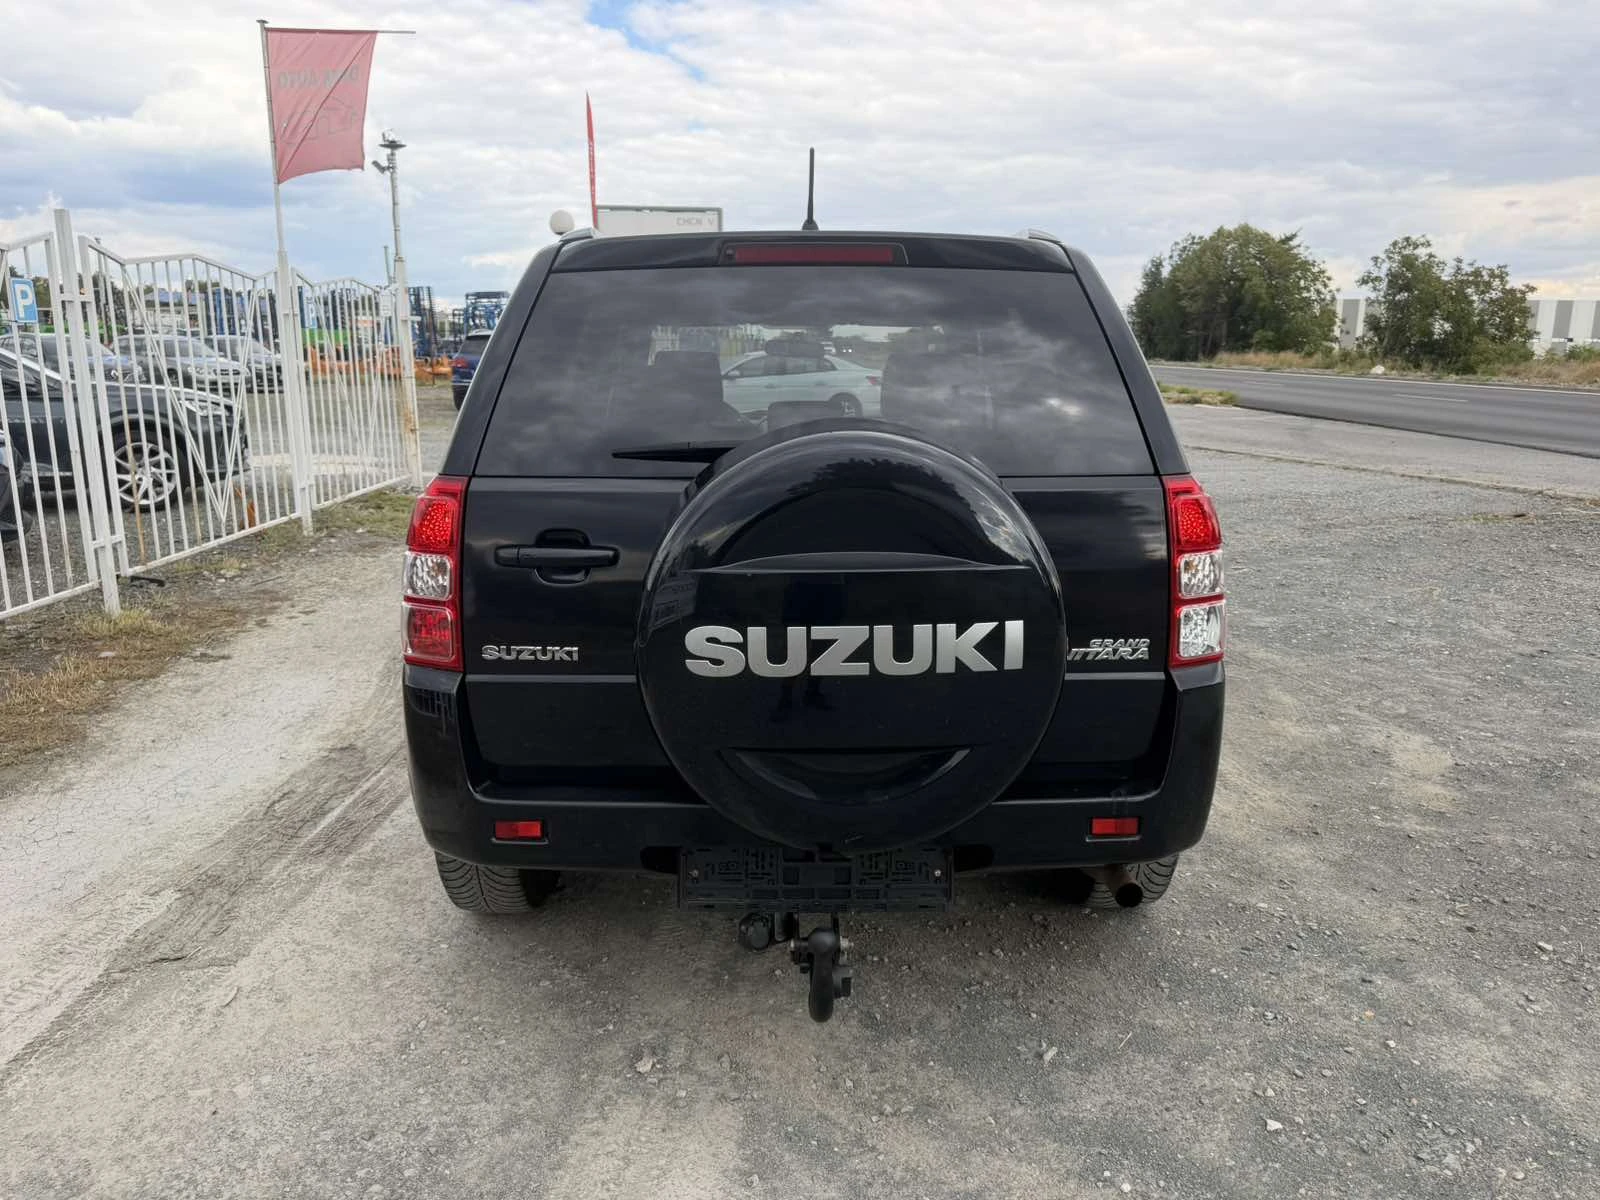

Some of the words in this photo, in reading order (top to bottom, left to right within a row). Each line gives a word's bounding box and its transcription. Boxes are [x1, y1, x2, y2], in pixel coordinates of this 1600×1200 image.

[15, 283, 33, 318] P
[481, 645, 579, 661] SUZUKI
[685, 619, 1025, 678] SUZUKI
[1089, 638, 1151, 648] GRAND
